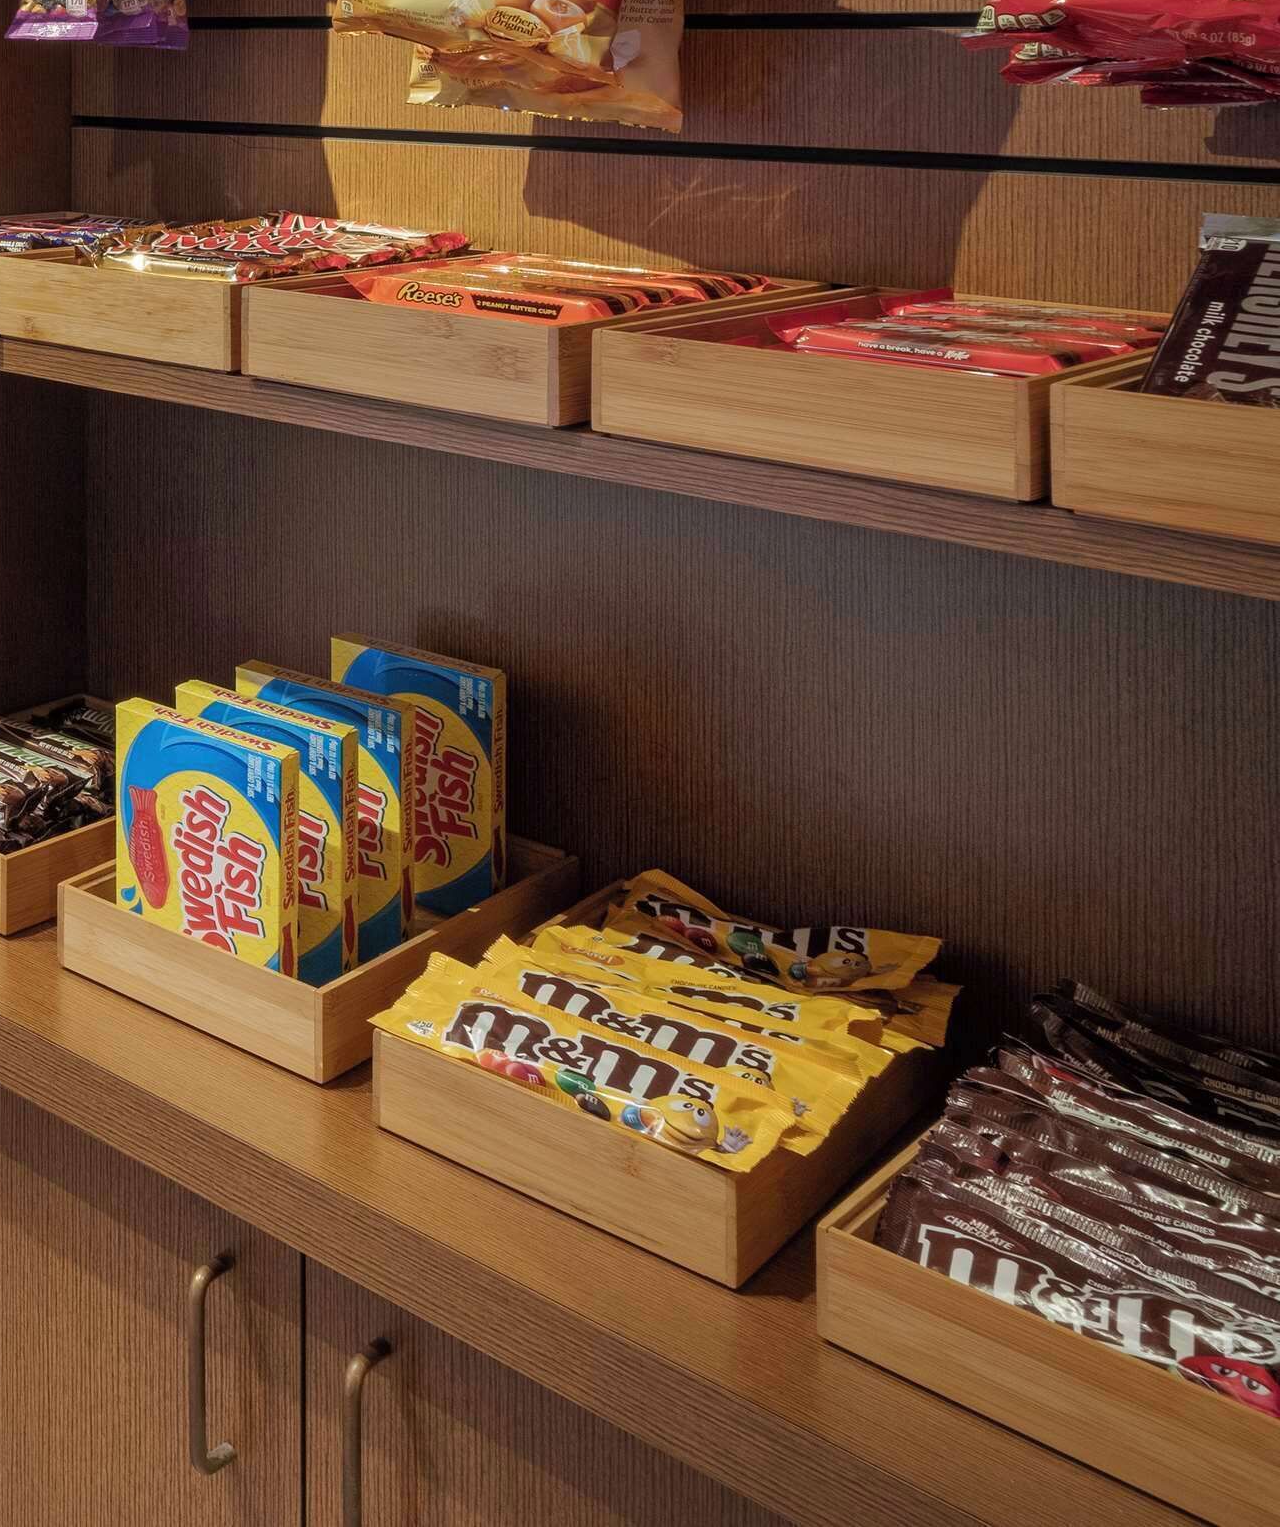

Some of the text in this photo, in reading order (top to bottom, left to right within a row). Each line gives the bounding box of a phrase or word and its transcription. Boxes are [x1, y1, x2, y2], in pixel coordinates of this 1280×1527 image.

[492, 7, 541, 30] Werther's
[629, 6, 659, 15] Butter
[645, 15, 673, 24] Cream
[490, 17, 536, 39] Original
[1227, 32, 1257, 46] (85g)
[397, 281, 462, 309] Reese's
[482, 300, 558, 318] PEANUT BUTTER CUPS
[857, 341, 936, 356] have break, have
[1173, 299, 1227, 385] milk chocolate
[193, 719, 278, 754] Swedish
[427, 744, 480, 845] Fish
[344, 804, 357, 884] Swedish
[173, 785, 234, 953] Swedish
[282, 825, 298, 911] Swedish
[215, 831, 269, 939] Fish
[518, 969, 777, 1073] m&m's
[441, 999, 721, 1107] m&m's
[1202, 1076, 1254, 1099] CHOCOLATE
[943, 1214, 1015, 1251] CHOCOLATE
[968, 1216, 1000, 1238] MILK
[1118, 1223, 1175, 1258] CHOCOLATE
[1176, 1218, 1217, 1236] CANDIES
